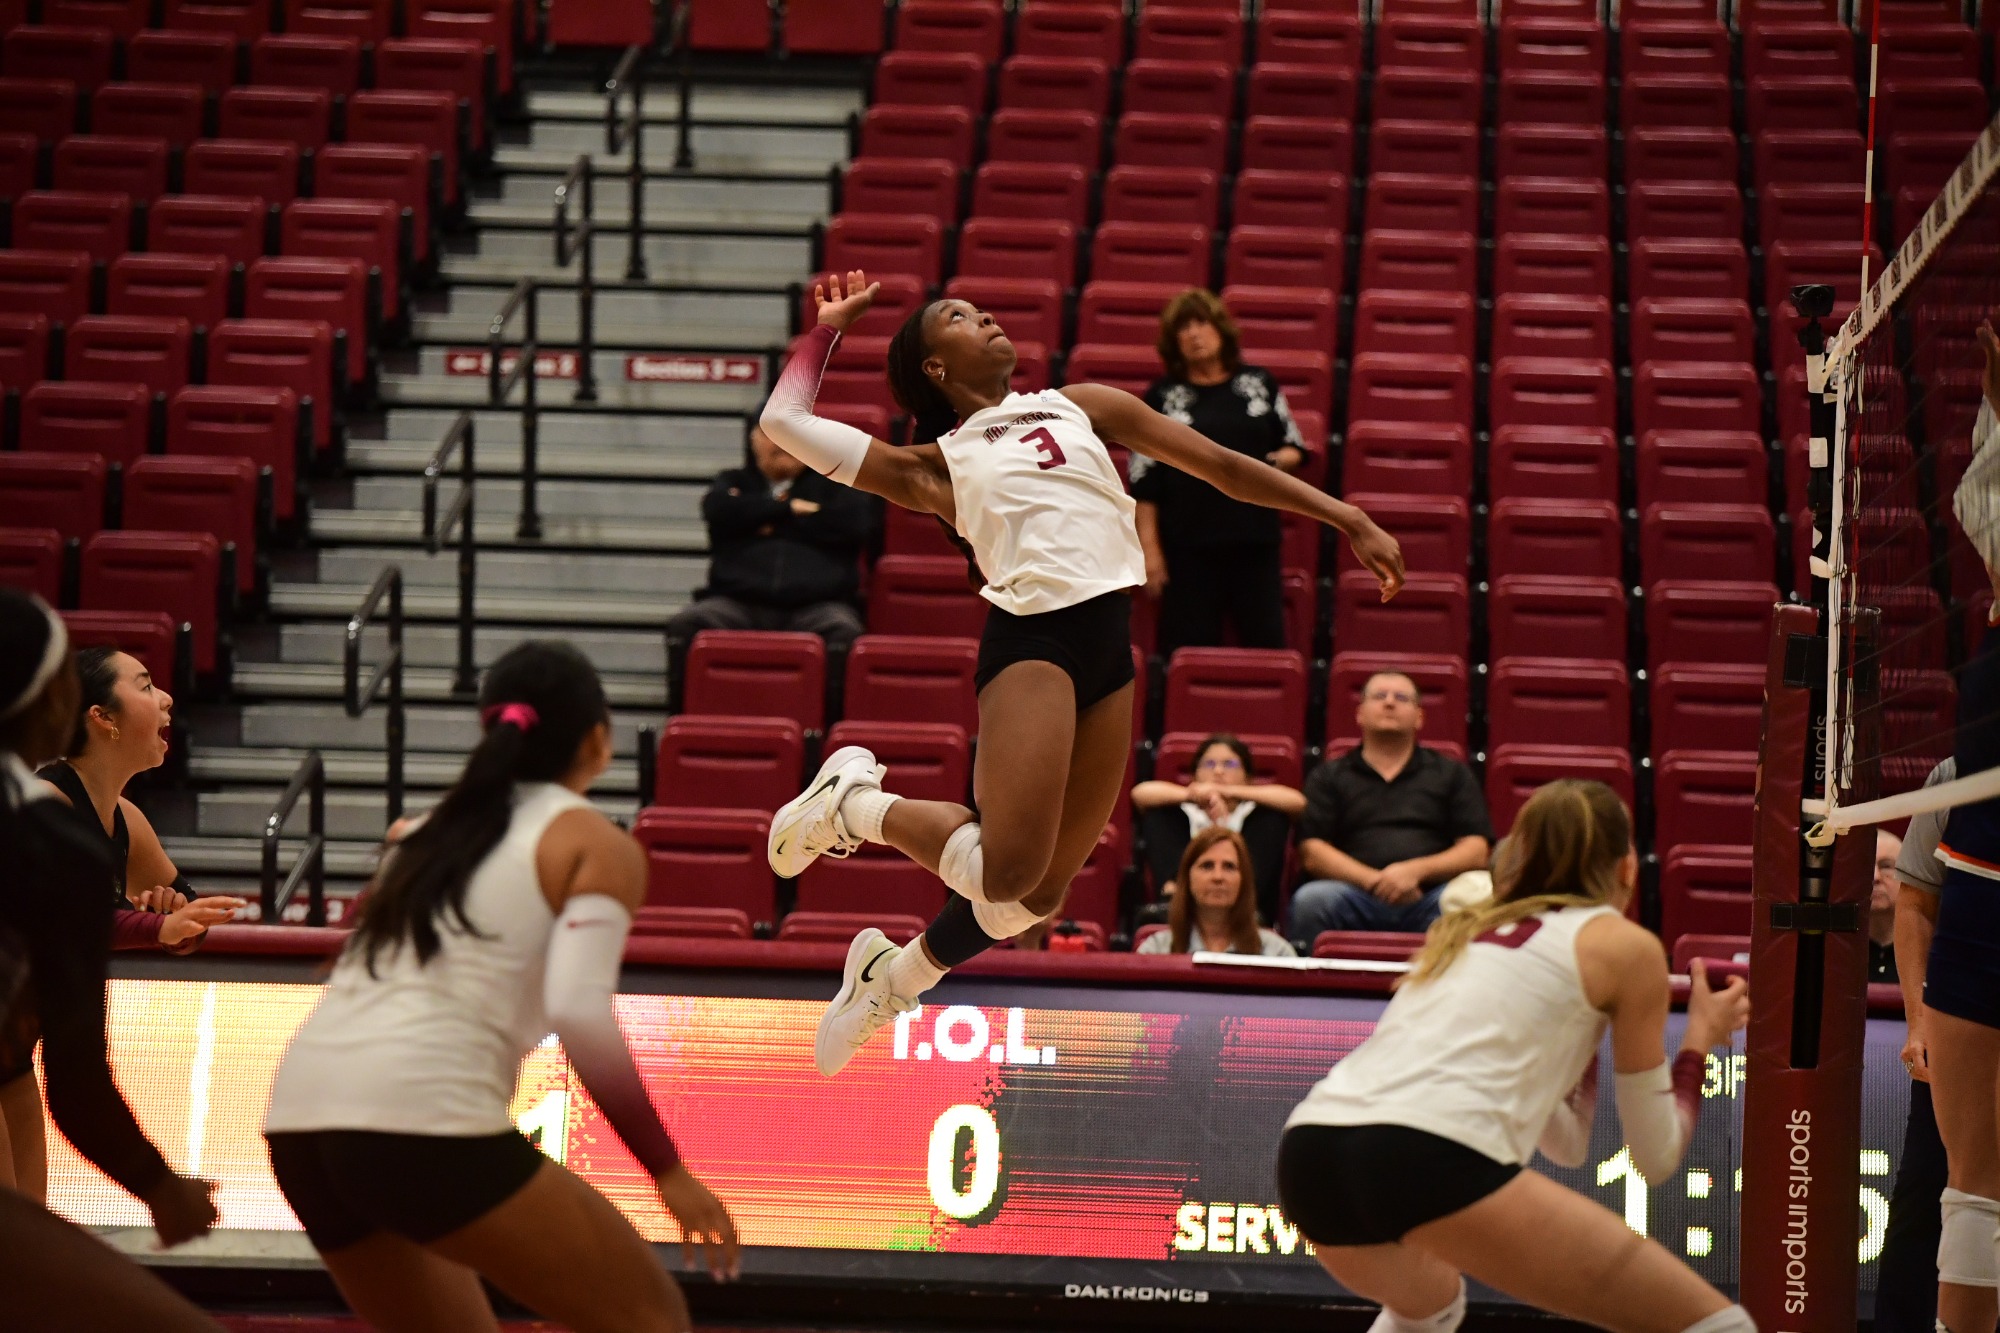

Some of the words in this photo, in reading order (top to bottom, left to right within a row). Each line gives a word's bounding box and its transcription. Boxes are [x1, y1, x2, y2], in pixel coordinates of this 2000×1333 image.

[1018, 426, 1067, 470] 3
[893, 1004, 1057, 1065] T.O.L.
[927, 1104, 1001, 1219] 0
[1785, 1109, 1813, 1198] sports
[1174, 1201, 1317, 1256] SERV
[1781, 1204, 1809, 1314] imports
[1064, 1283, 1210, 1303] DAKTRONICS
